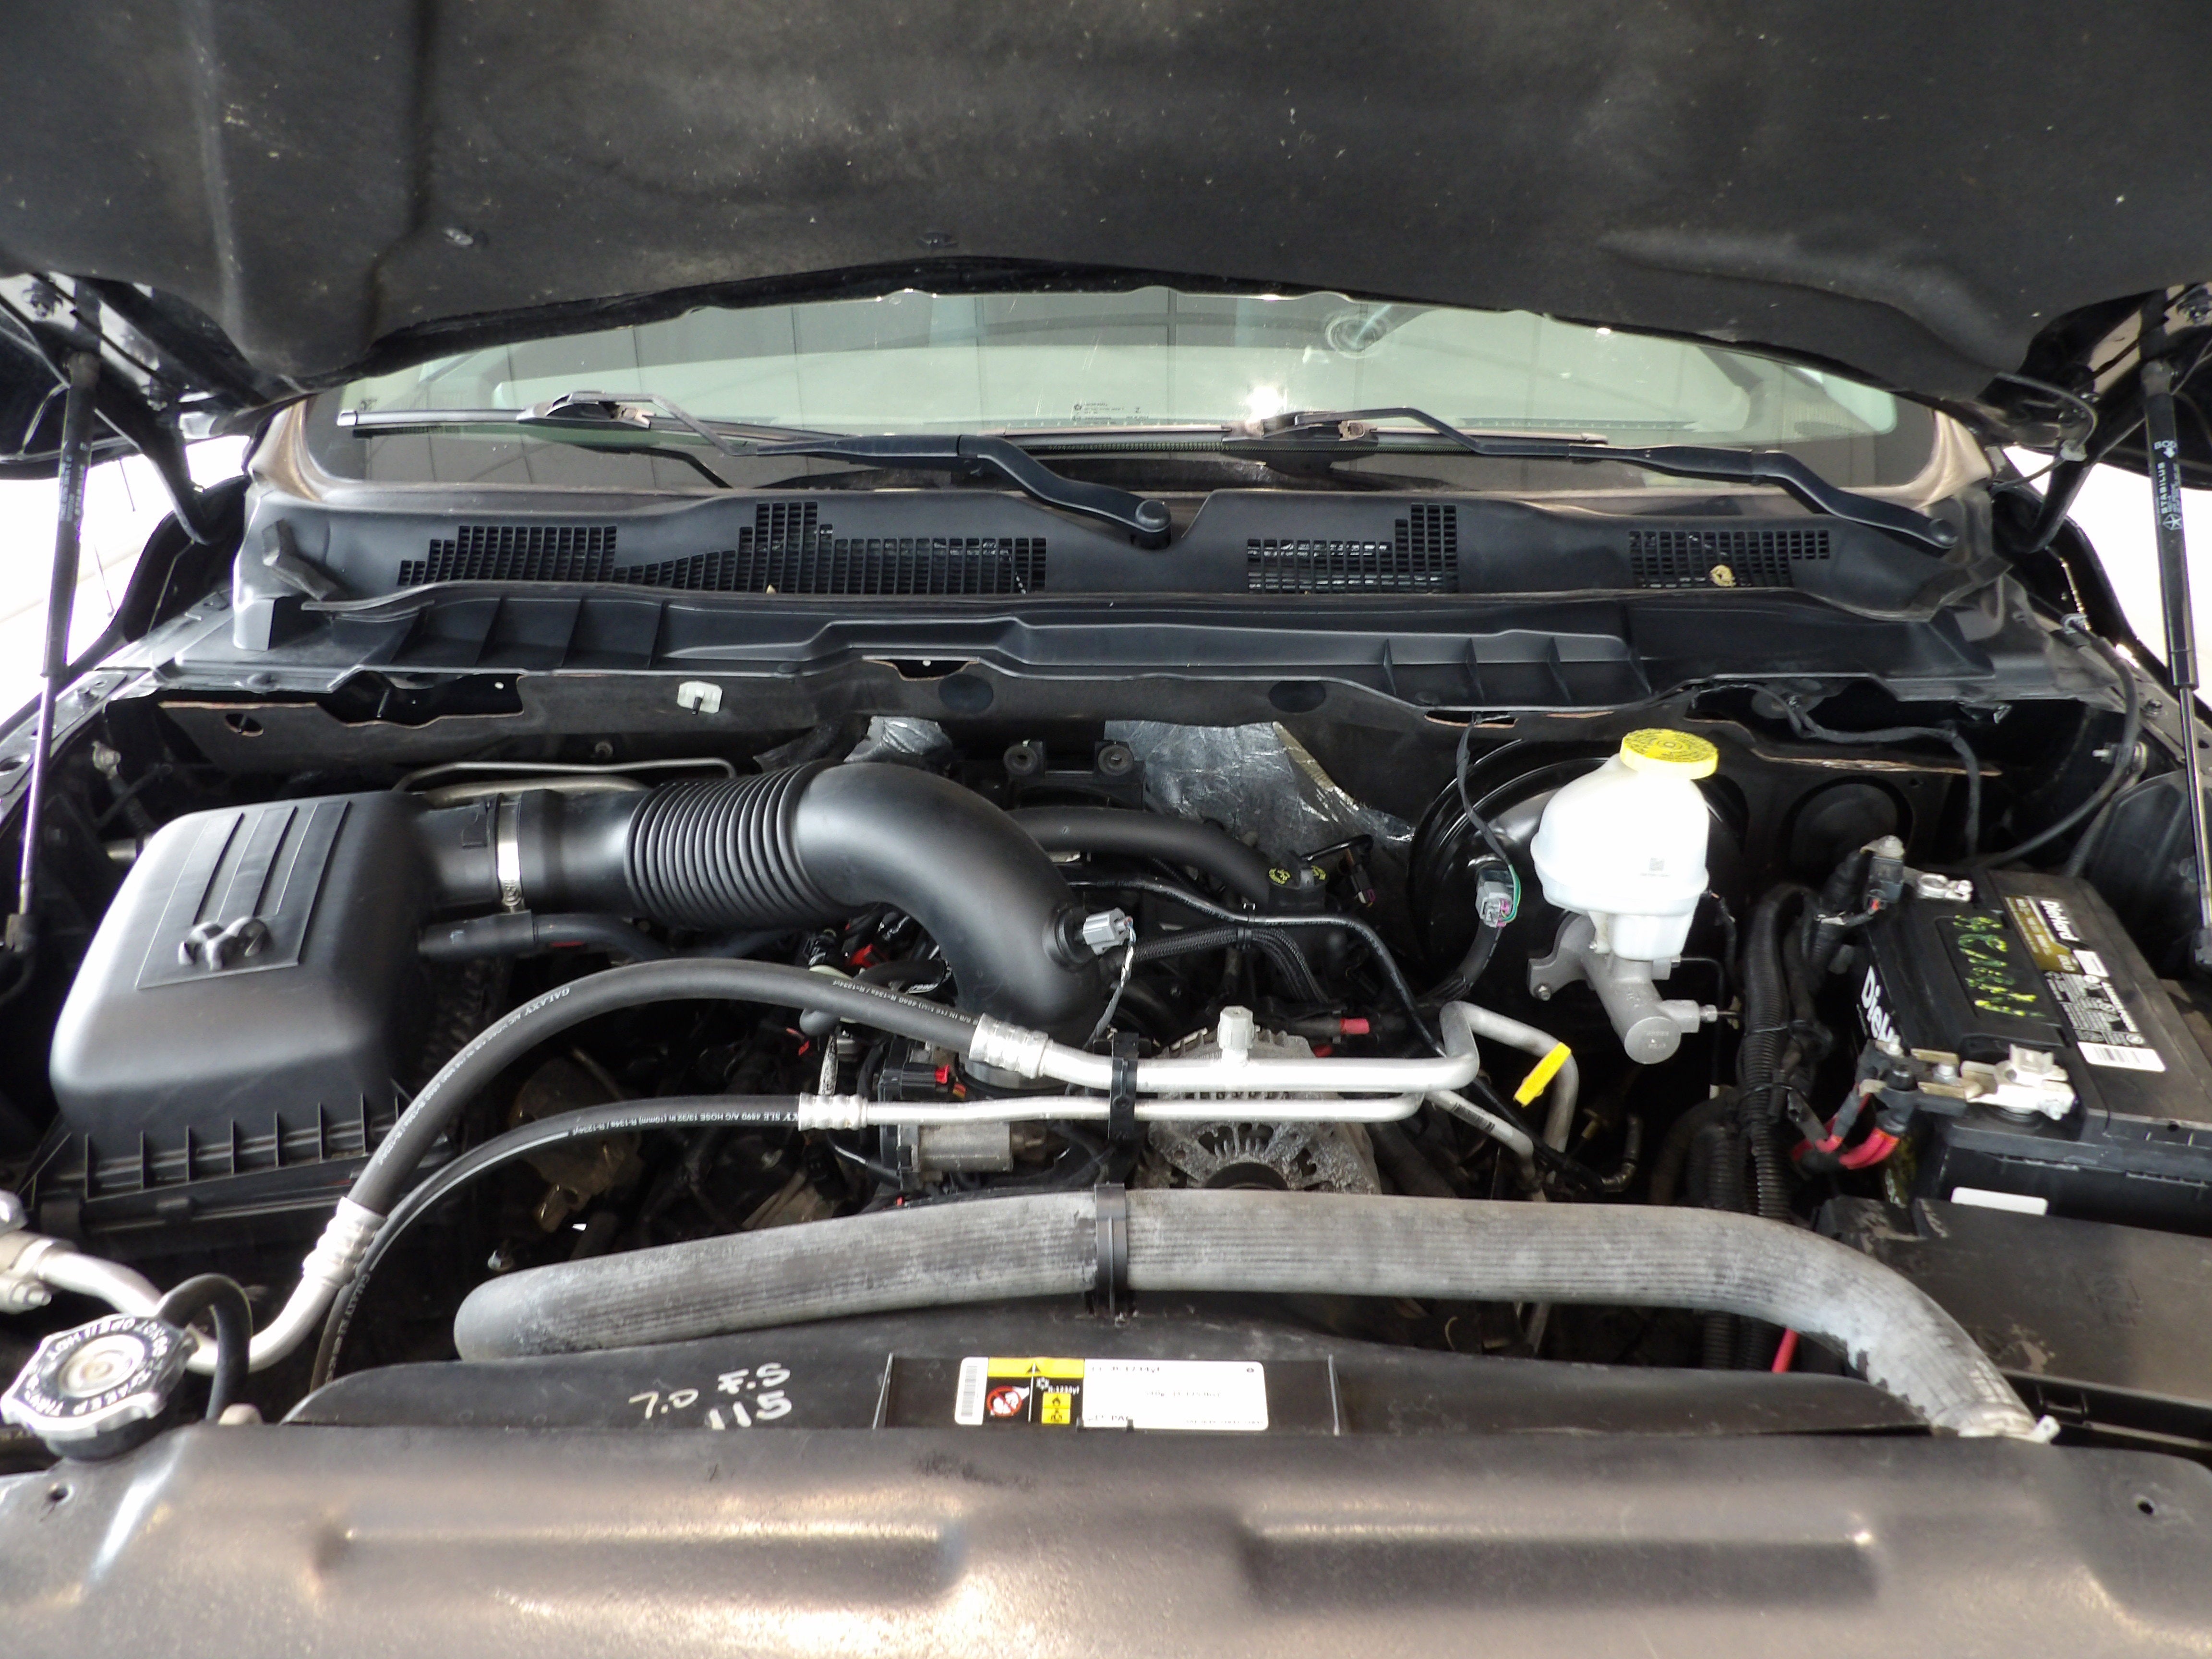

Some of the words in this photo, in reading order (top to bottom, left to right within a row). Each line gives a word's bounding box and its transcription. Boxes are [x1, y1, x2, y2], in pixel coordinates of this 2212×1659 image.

[2157, 462, 2168, 514] STABILUS
[2040, 901, 2079, 942] DieHard
[522, 986, 571, 1017] GALAXY
[610, 1117, 637, 1129] R-134a
[638, 1113, 667, 1125] (10mm)
[700, 1113, 723, 1121] HOSE
[84, 1318, 136, 1337] OPEN
